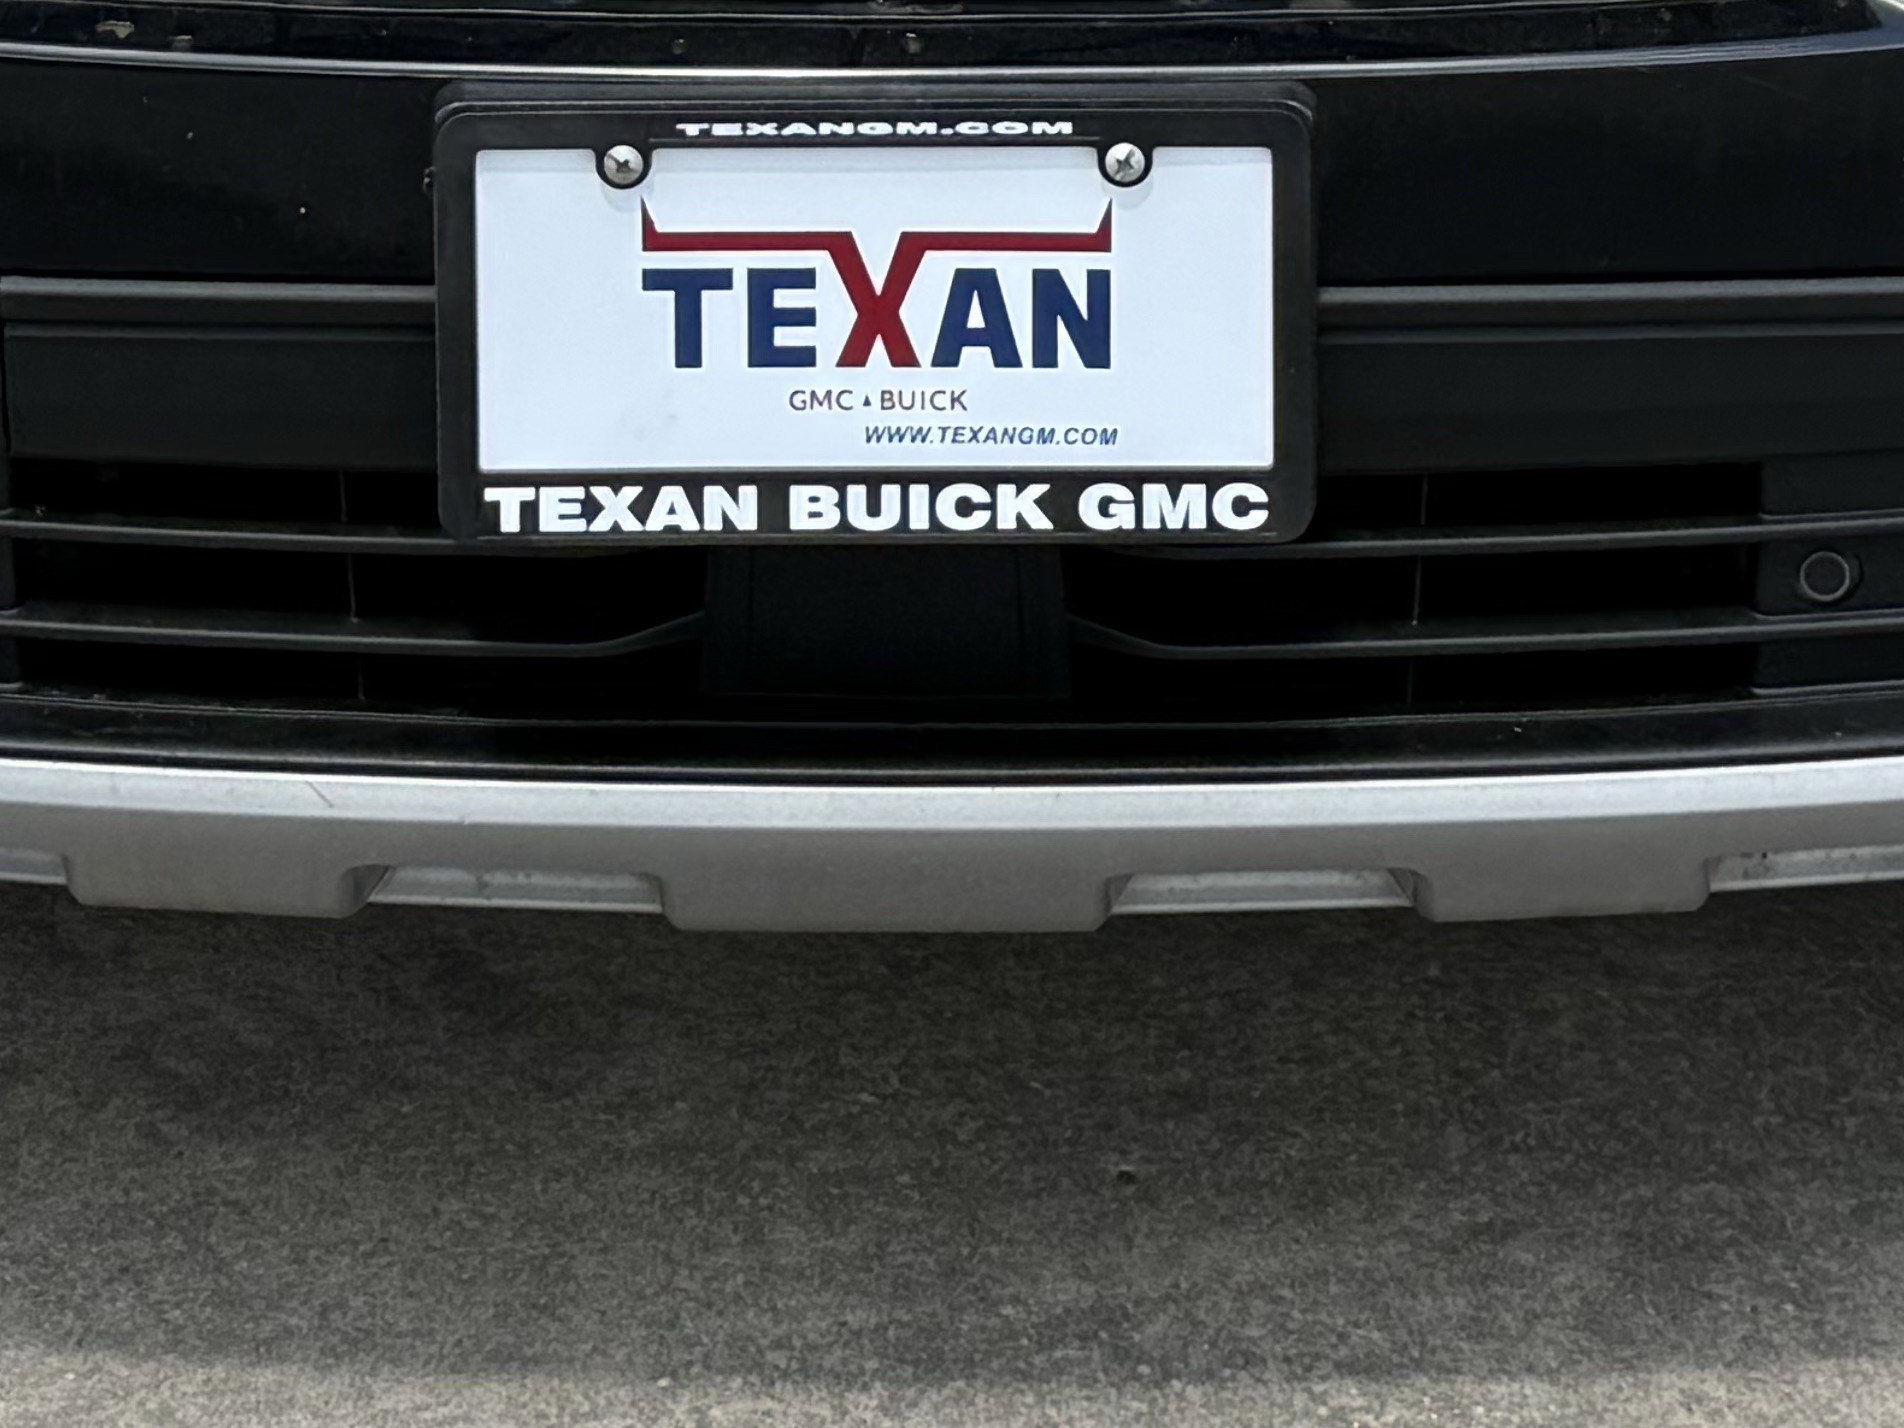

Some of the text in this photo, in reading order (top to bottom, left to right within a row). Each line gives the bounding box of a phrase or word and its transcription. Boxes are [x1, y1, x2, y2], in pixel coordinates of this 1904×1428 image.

[675, 119, 1075, 137] TEXANGM.COM
[640, 197, 1114, 369] TEXAN
[788, 388, 968, 412] GMC BUICK
[864, 424, 1119, 447] WWW.TEXANGM.COM
[483, 481, 1270, 534] TEXAN BUICK GMC
